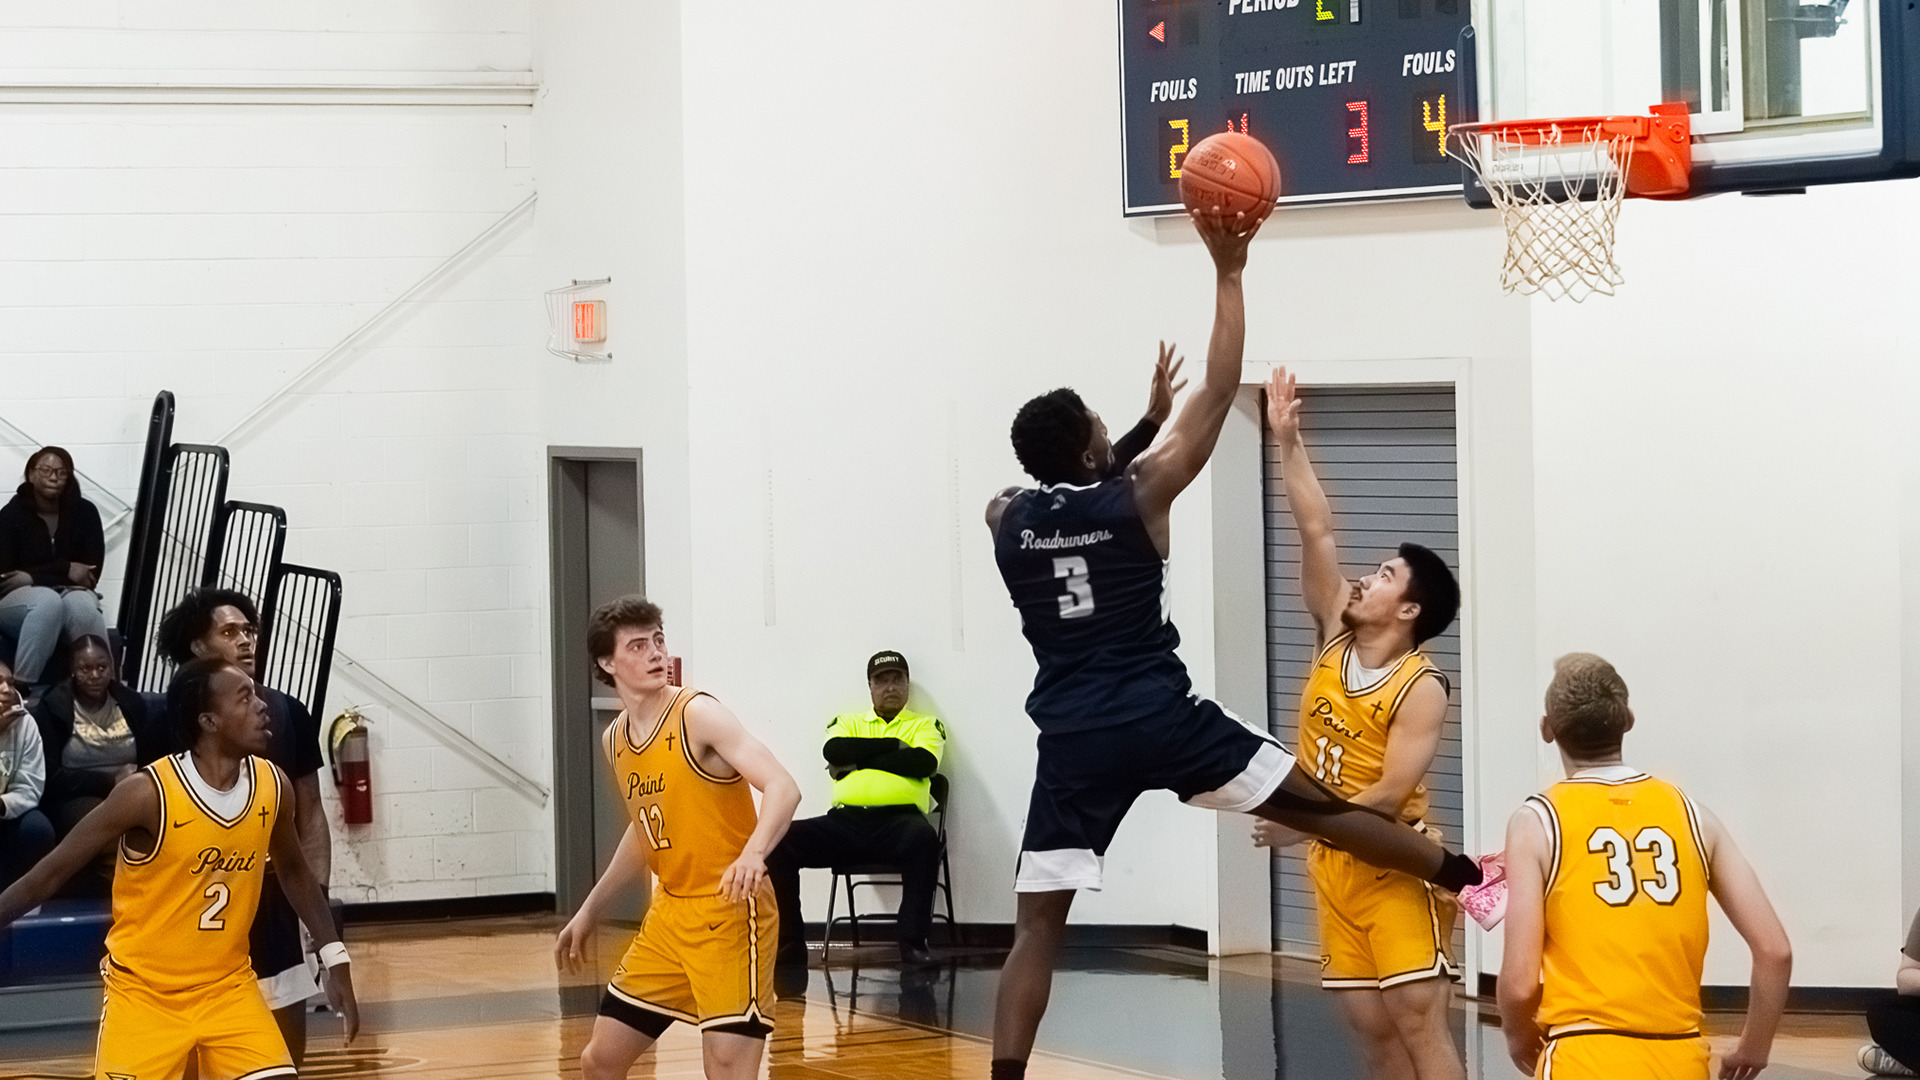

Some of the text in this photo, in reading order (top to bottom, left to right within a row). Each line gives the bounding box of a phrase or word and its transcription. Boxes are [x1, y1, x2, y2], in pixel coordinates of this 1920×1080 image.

[1235, 60, 1357, 95] TIME OUTS LEFT
[1402, 49, 1456, 77] FOULS
[1150, 77, 1198, 103] FOULS
[1168, 118, 1189, 179] 2
[1345, 101, 1368, 164] 3
[1423, 94, 1446, 157] 4
[574, 302, 595, 339] EXIT
[1020, 528, 1113, 550] Roadrunners
[1052, 555, 1095, 619] 3
[1309, 696, 1364, 740] Point
[1314, 735, 1345, 787] 11
[627, 771, 666, 800] Point
[638, 803, 672, 852] 12
[190, 845, 256, 876] Point
[1586, 826, 1682, 907] 33
[198, 881, 231, 931] 2
